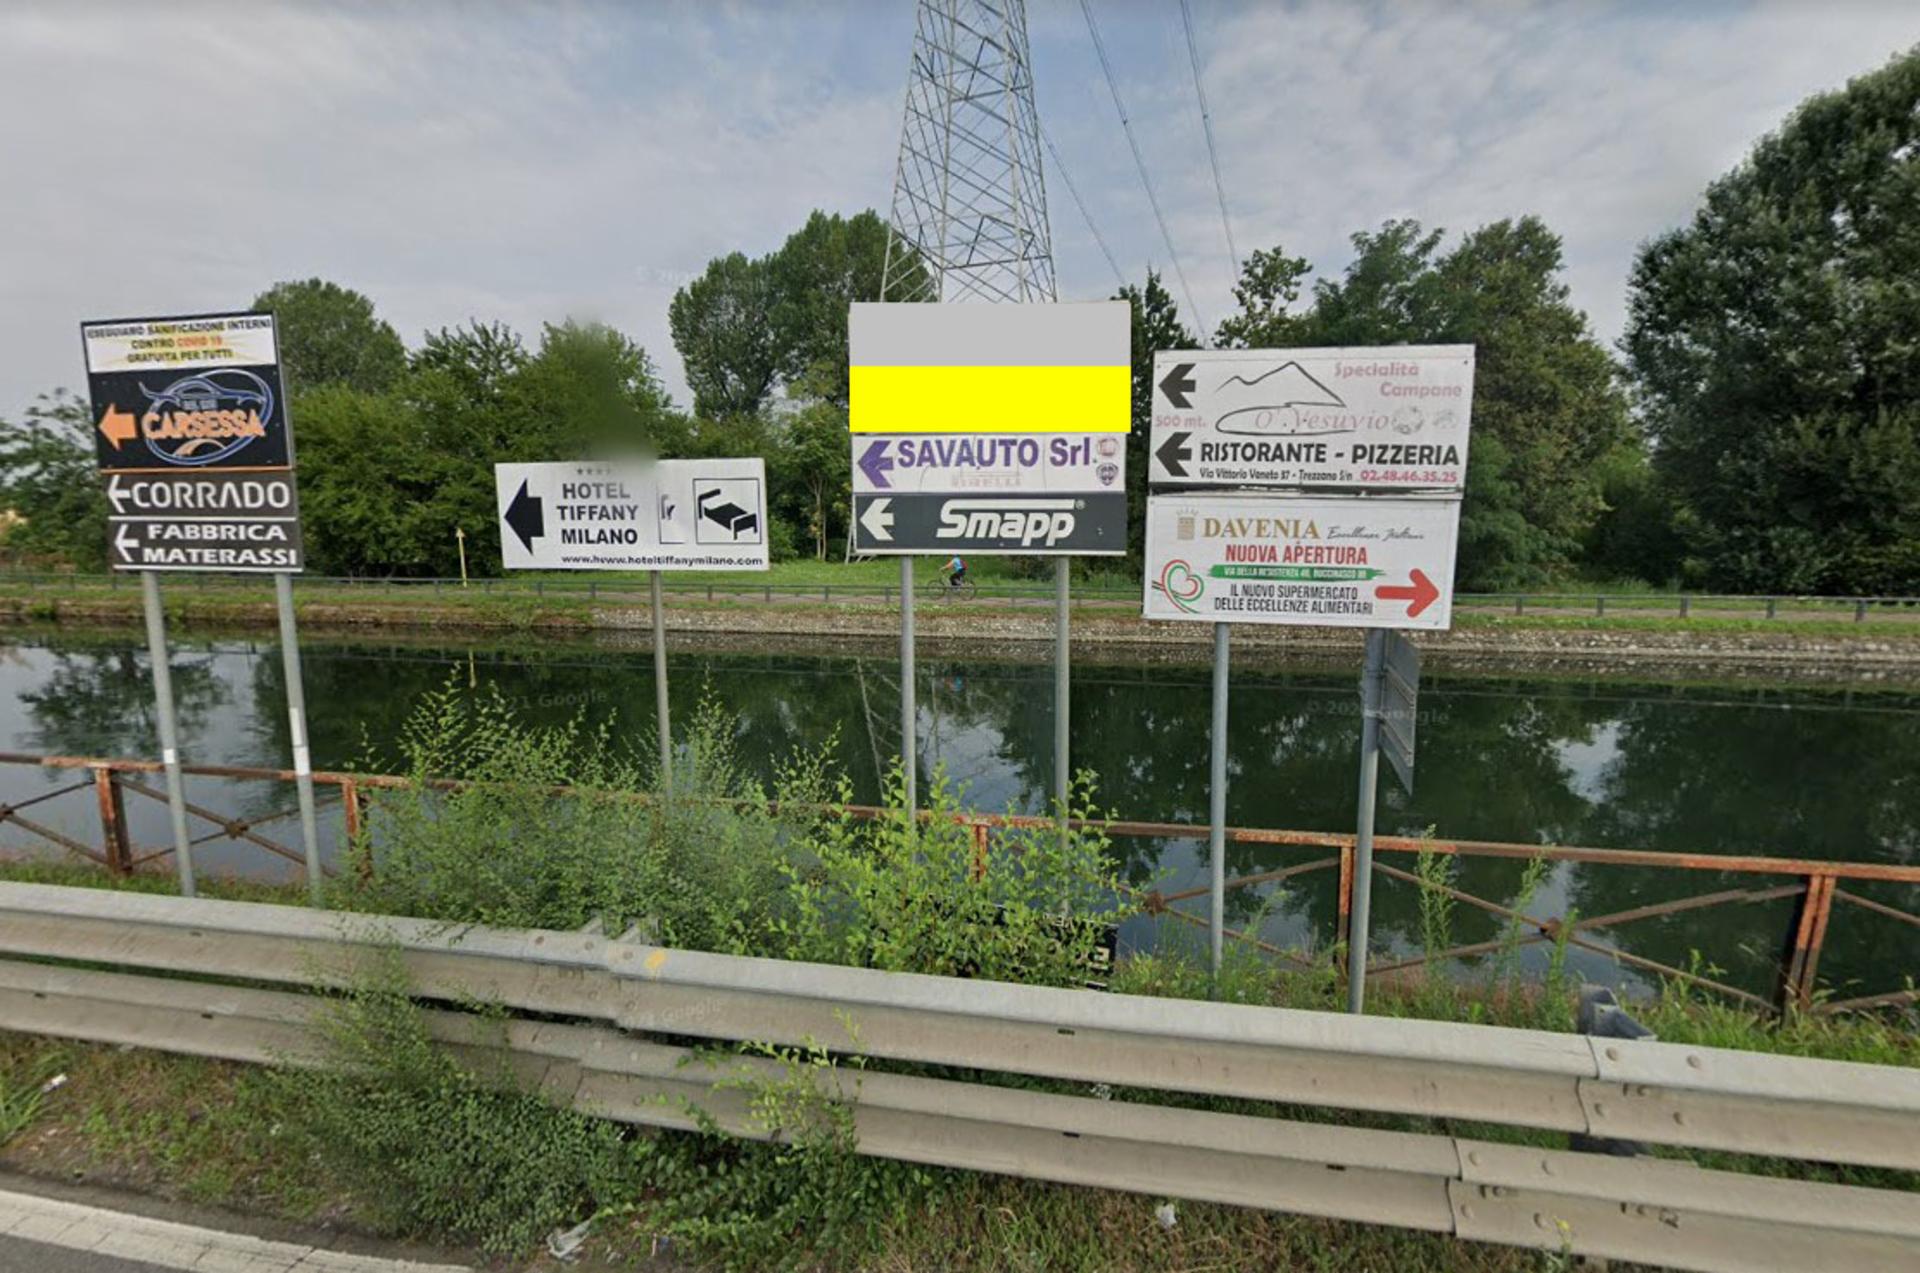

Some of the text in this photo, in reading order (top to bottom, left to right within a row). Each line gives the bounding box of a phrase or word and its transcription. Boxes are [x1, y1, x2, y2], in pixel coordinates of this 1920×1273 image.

[147, 321, 226, 335] SANIFICAZIONE
[227, 318, 271, 331] INTERNI
[131, 338, 175, 349] CONTRO
[176, 336, 208, 347] COVID
[127, 348, 233, 363] GRATUITA PER TUTTI
[1334, 361, 1419, 378] Specialità
[1380, 382, 1462, 399] Campane
[142, 408, 266, 440] CARSESSA
[1156, 415, 1181, 427] 500
[1293, 410, 1390, 431] Vesuvio
[897, 438, 1039, 468] SAVAUTO
[1200, 442, 1327, 463] RISTORANTE
[1351, 444, 1460, 466] PIZZERIA
[1200, 467, 1214, 479] Via
[1215, 468, 1247, 480] Vittorio
[1250, 469, 1279, 480] Veneto
[1299, 469, 1338, 481] Trezzano
[131, 481, 291, 509] CORRADO
[562, 482, 631, 500] HOTEL
[556, 505, 639, 521] TIFFANY
[147, 523, 288, 541] FABBRICA
[936, 499, 1076, 547] Smapp
[1203, 517, 1321, 540] DAVENIA
[561, 528, 638, 545] MILANO
[143, 547, 297, 566] MATERASSI
[1225, 544, 1368, 565] NUOVA APERTURA
[1230, 584, 1358, 600] IL NUOVO SUPERMERCATO
[1214, 597, 1374, 615] DELLE ECCELLENZE ALIMENTARI
